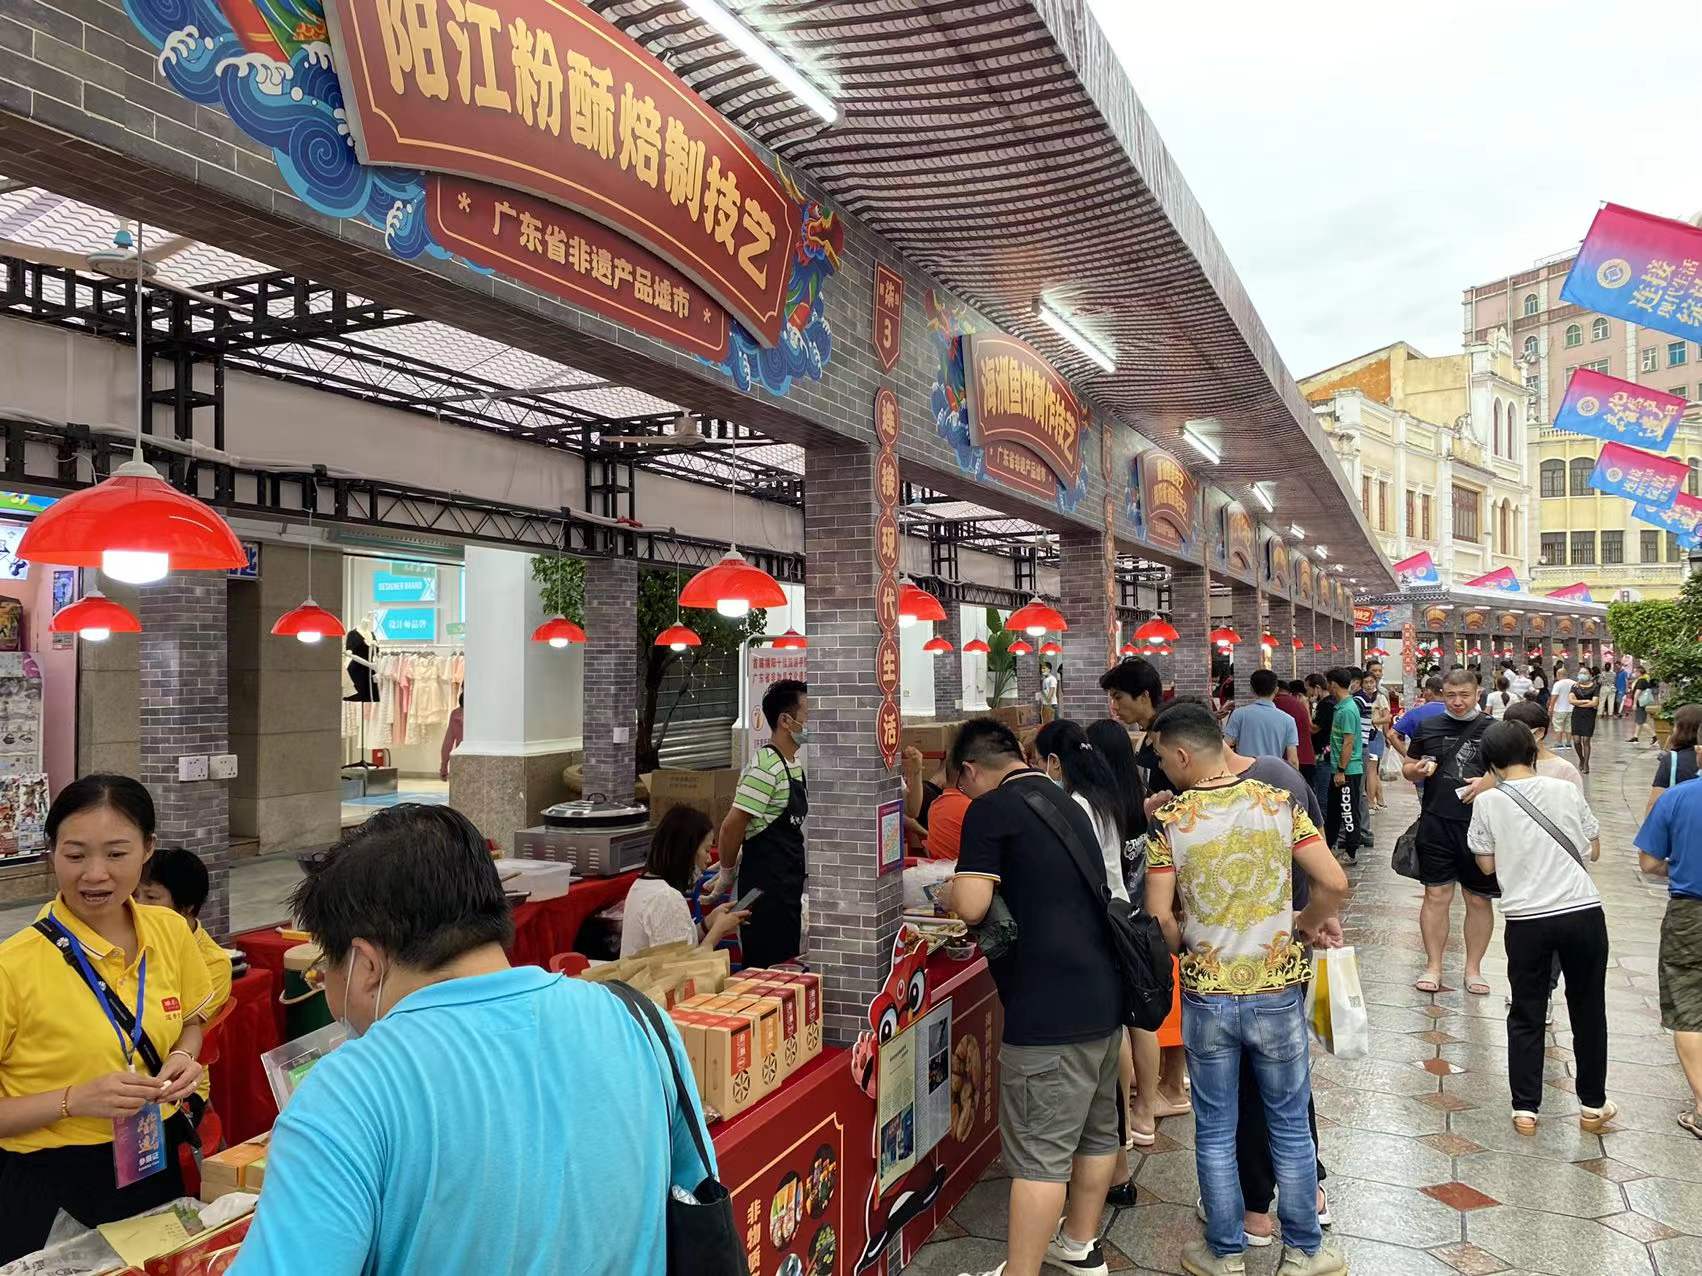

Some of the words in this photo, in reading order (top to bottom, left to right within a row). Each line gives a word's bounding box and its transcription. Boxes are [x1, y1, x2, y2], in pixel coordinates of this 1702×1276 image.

[376, 0, 776, 290] 阳江粉酥焙制技艺
[492, 200, 690, 319] 广东省非遗产品墟市
[883, 318, 892, 349] 3
[881, 396, 896, 746] 连接现代生活
[1340, 786, 1354, 832] adidas
